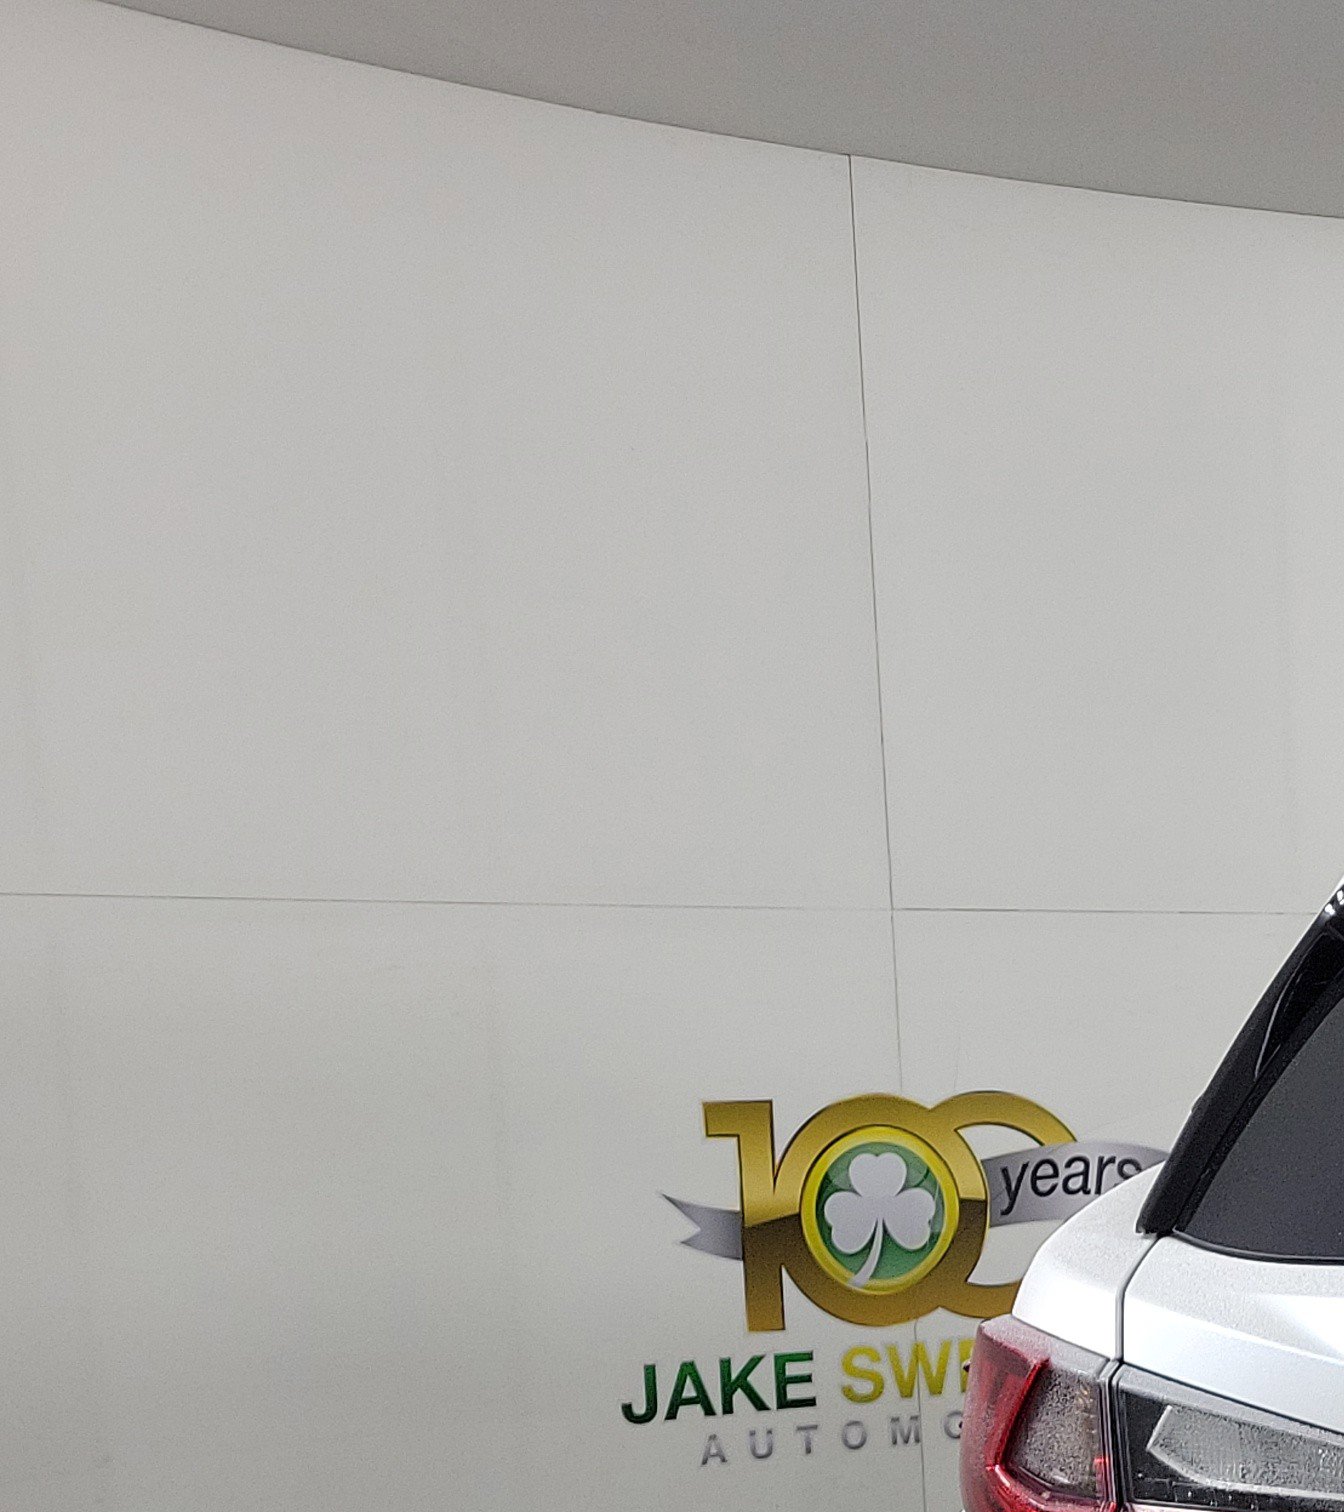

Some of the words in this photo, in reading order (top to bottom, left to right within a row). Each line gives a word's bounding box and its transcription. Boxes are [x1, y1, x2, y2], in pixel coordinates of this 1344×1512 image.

[702, 1091, 1078, 1332] 100
[622, 1350, 817, 1424] JAKE
[700, 1411, 963, 1466] AUTOMO
